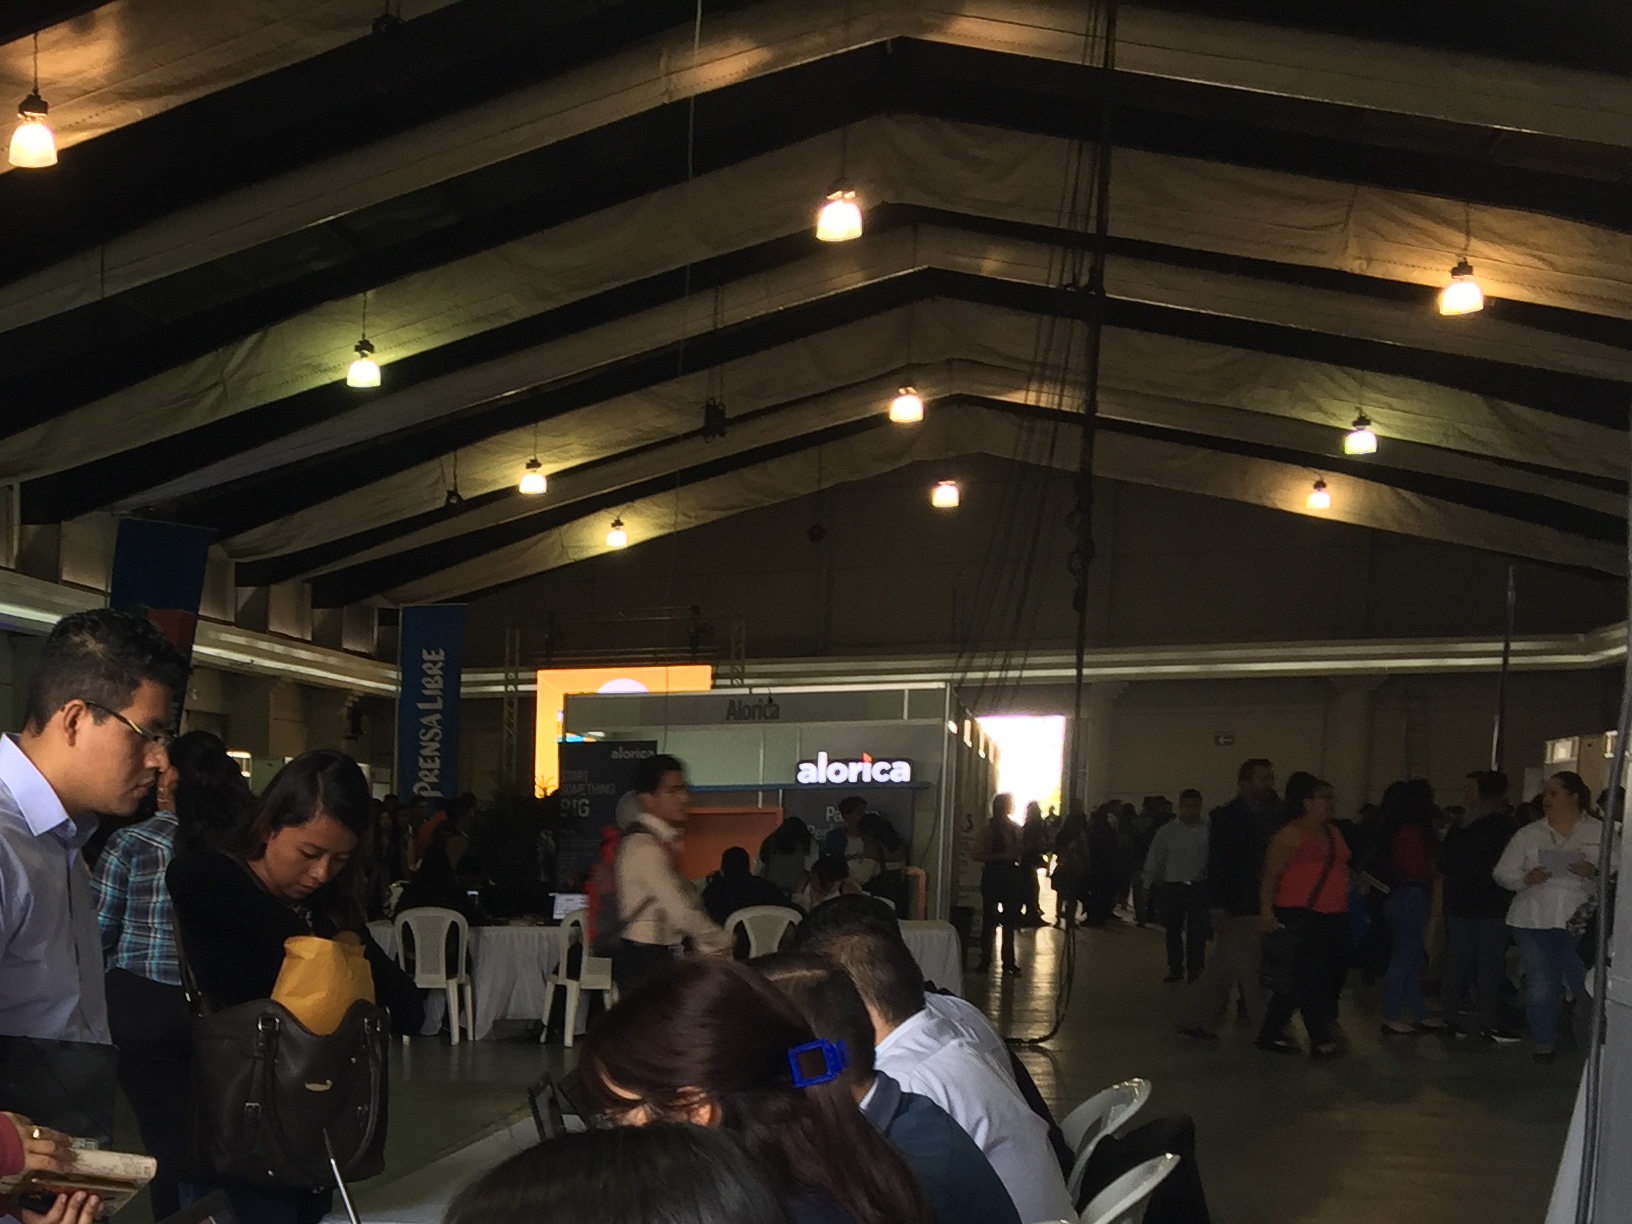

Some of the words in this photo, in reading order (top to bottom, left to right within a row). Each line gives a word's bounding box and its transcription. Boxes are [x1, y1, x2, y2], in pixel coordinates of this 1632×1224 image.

[416, 648, 446, 711] LIBRE
[725, 699, 780, 721] Alorica
[412, 713, 444, 798] PRENSA
[796, 751, 912, 784] alorica
